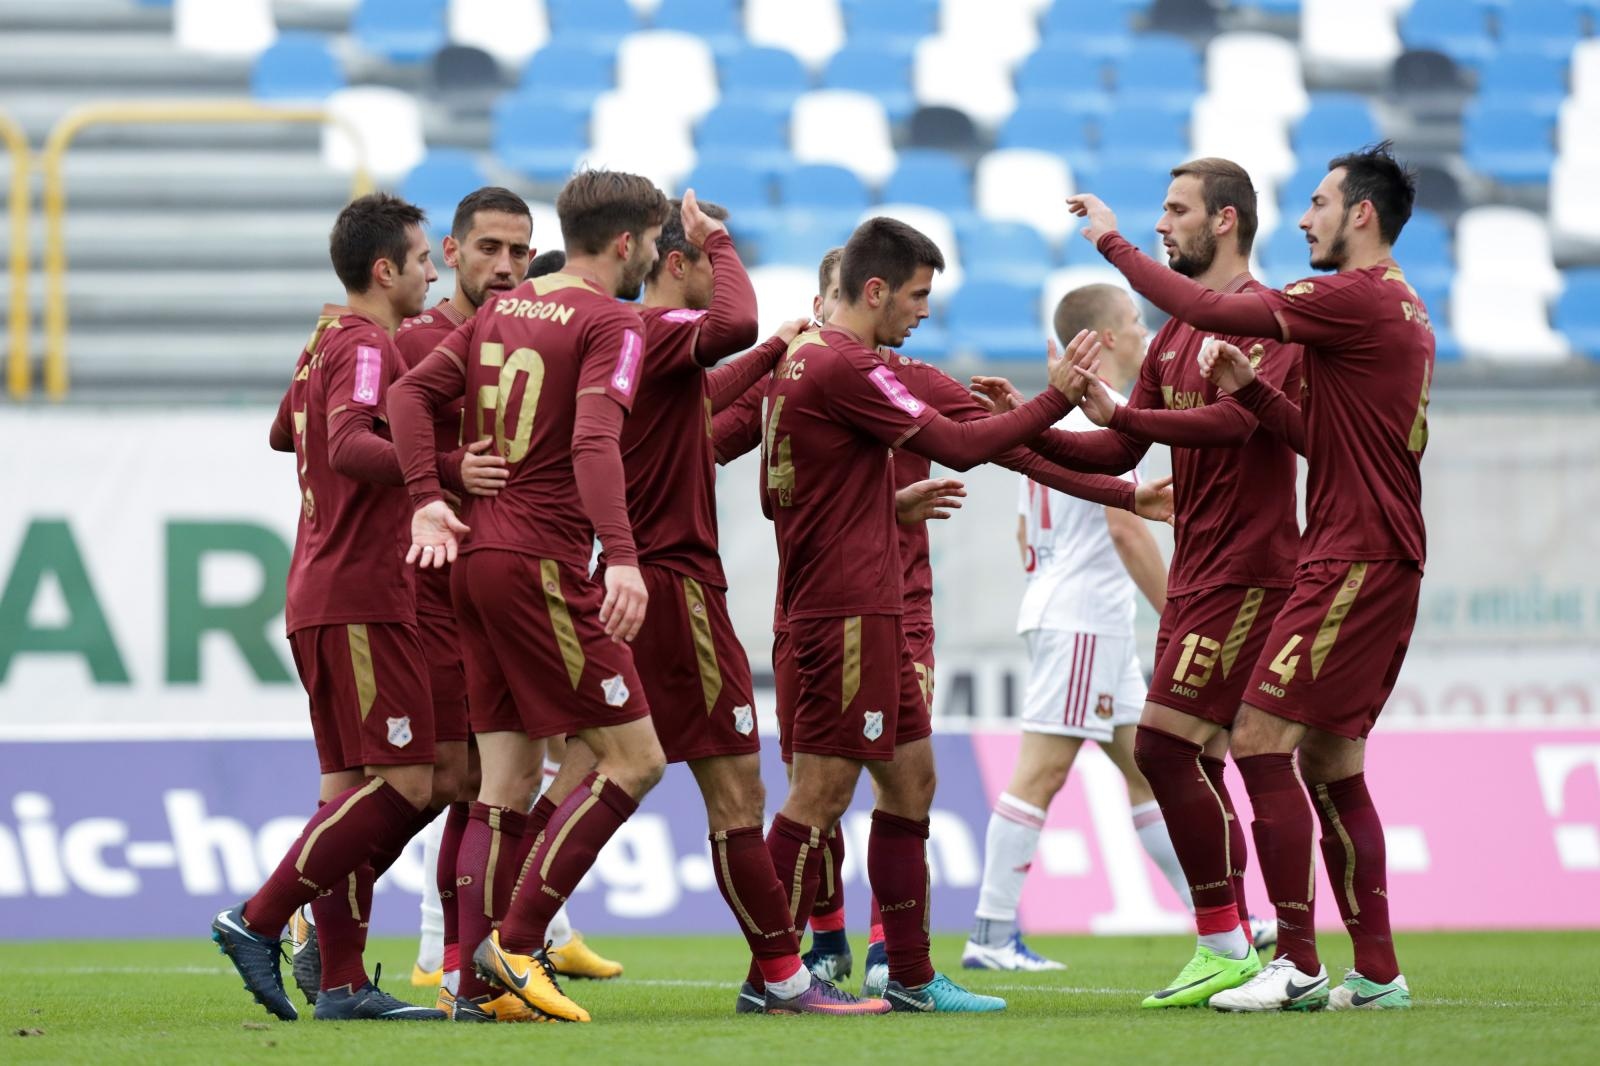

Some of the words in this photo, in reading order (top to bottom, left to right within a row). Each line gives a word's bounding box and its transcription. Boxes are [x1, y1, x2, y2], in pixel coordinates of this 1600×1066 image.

[1173, 633, 1221, 688] 13
[1269, 634, 1303, 685] 4
[1170, 684, 1198, 699] JAKO
[1259, 681, 1285, 698] JAKO
[881, 899, 917, 912] JAKO
